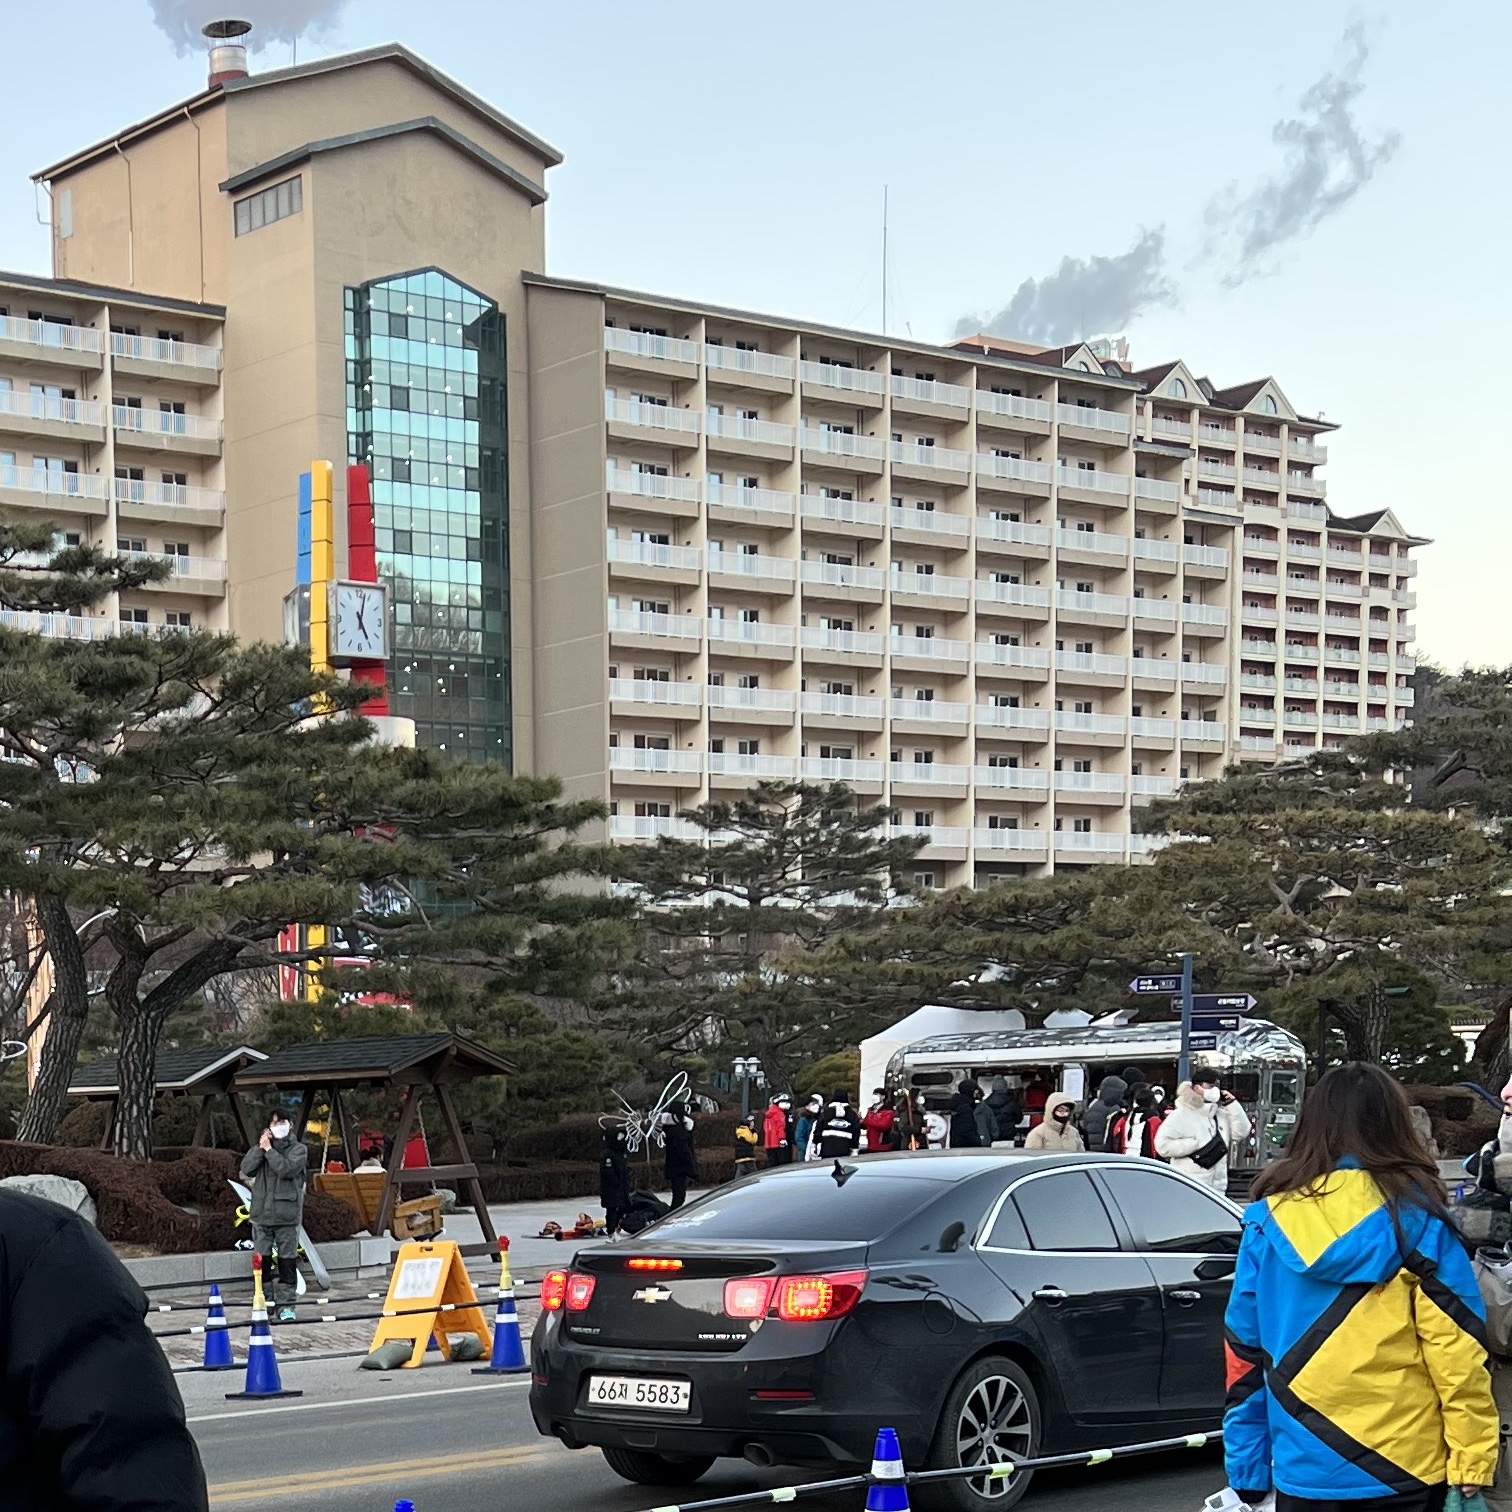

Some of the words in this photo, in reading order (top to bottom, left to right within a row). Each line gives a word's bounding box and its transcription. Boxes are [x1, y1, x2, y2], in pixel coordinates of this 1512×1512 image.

[355, 588, 364, 599] 12
[377, 618, 382, 628] 3
[357, 642, 363, 652] 6
[635, 1383, 681, 1405] 5583
